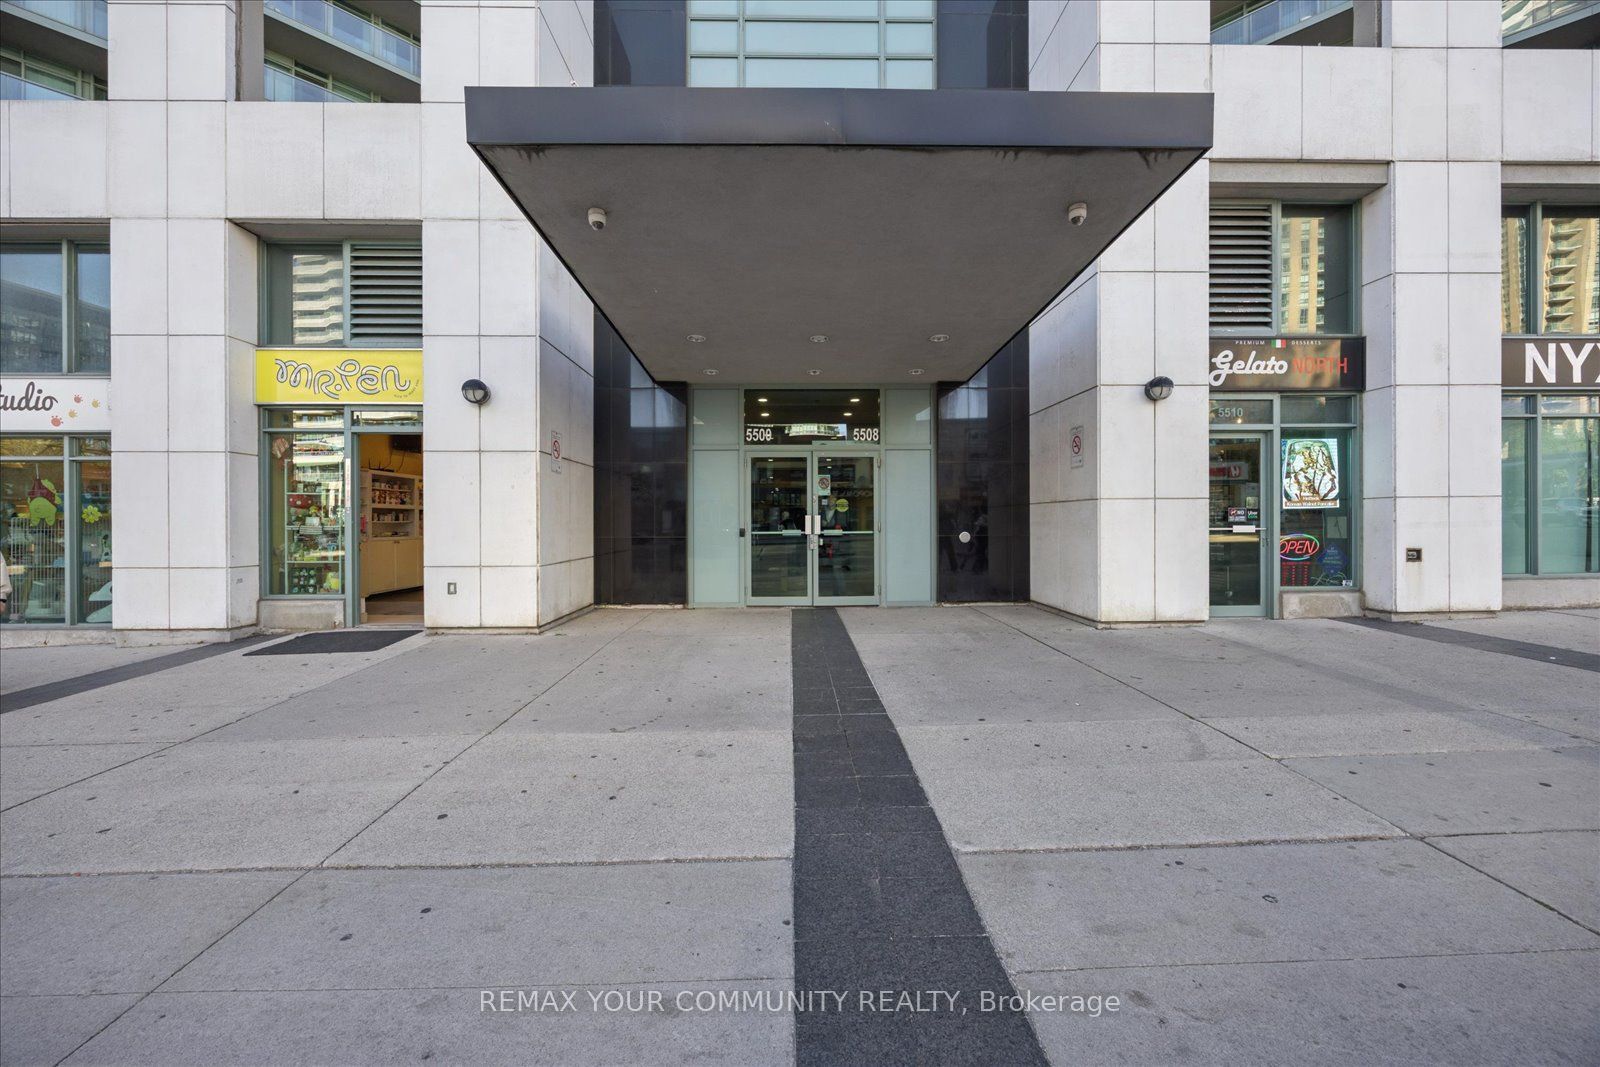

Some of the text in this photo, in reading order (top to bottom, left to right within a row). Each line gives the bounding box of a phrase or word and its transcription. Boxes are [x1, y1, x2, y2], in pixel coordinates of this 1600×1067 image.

[1209, 350, 1348, 386] Gelato NORTH
[1525, 343, 1600, 383] NY
[1218, 407, 1243, 417] 5510
[853, 428, 879, 441] 5508
[1280, 540, 1316, 554] OPEN
